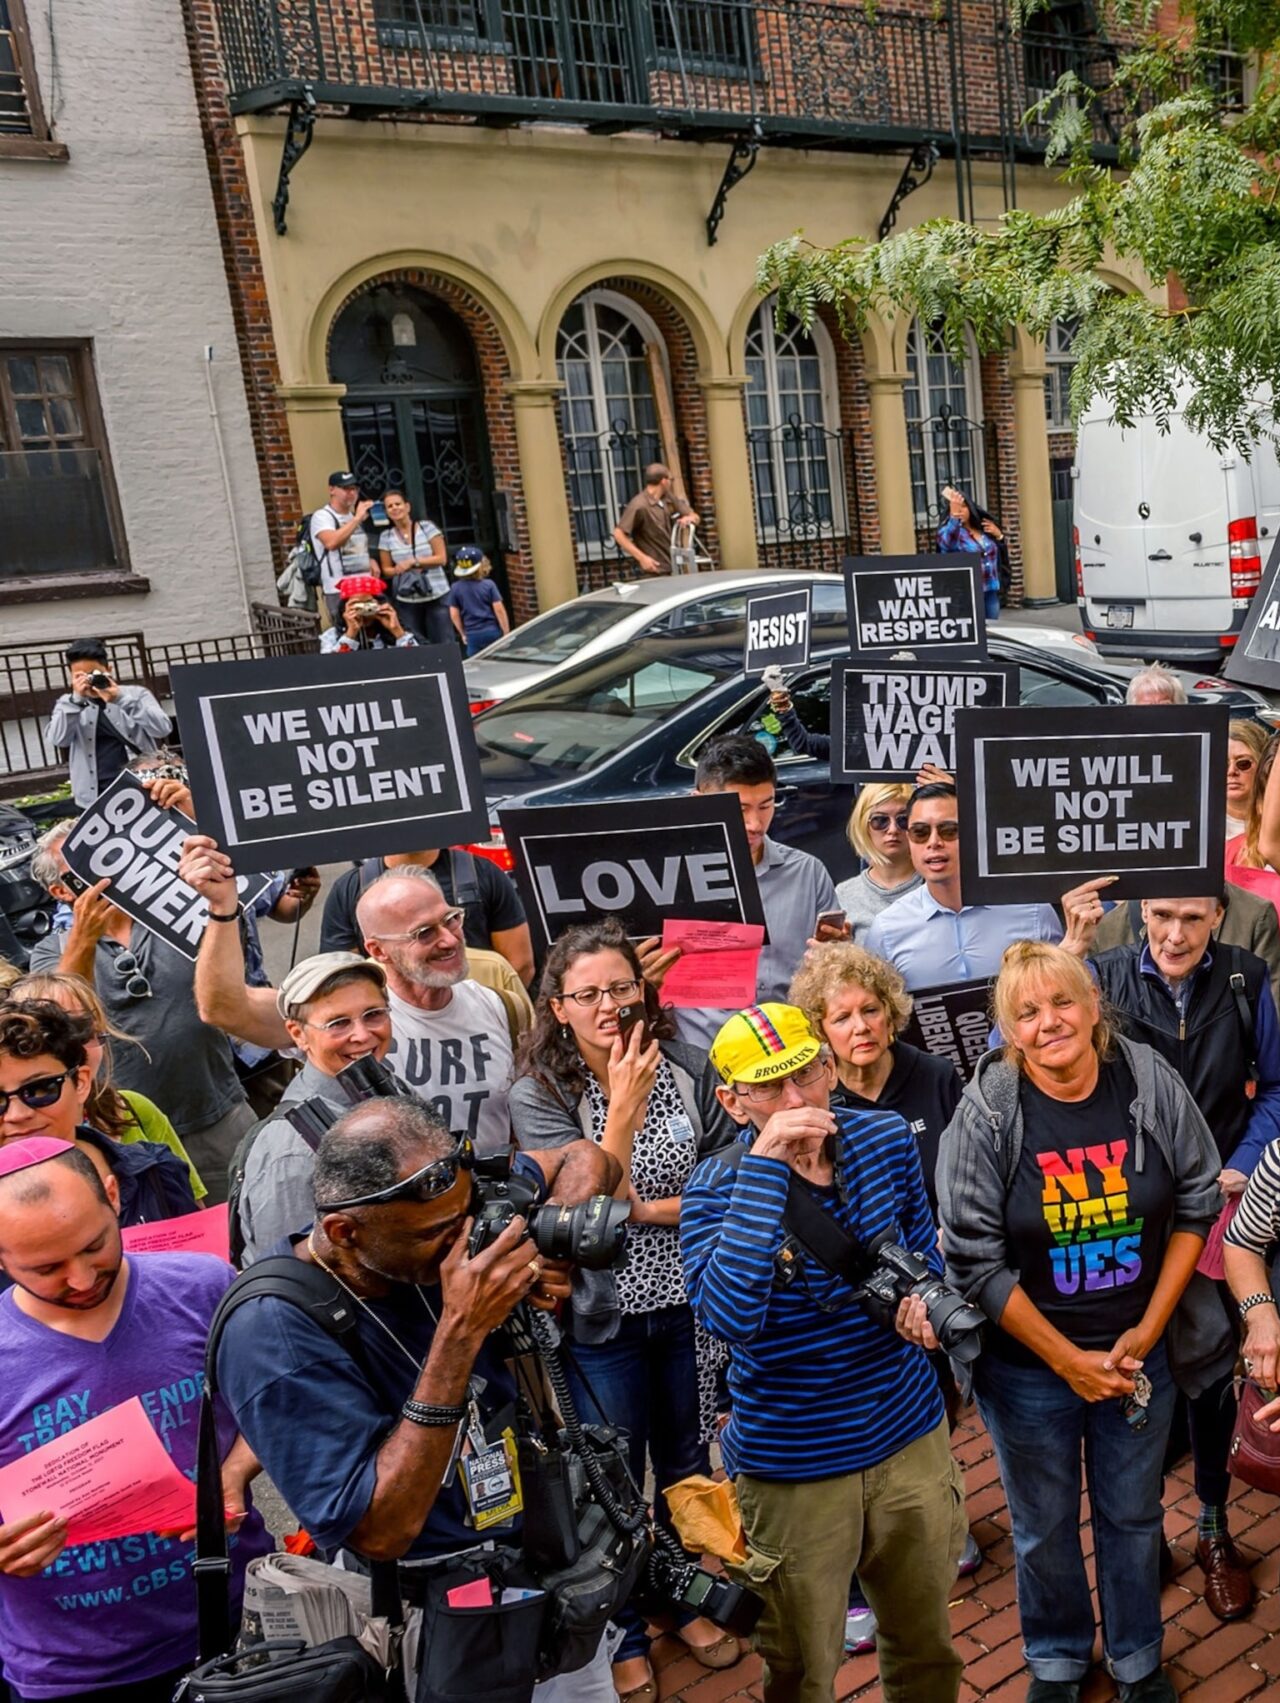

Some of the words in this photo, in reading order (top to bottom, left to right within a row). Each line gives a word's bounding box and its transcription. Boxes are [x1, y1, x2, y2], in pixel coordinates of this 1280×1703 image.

[894, 576, 934, 598] WE
[878, 597, 951, 620] WANT
[748, 612, 808, 651] RESIST
[860, 618, 972, 643] RESPECT
[862, 674, 987, 706] TRUMP
[243, 709, 311, 745] WE
[317, 698, 418, 736] WILL
[862, 703, 957, 735] WAG
[296, 736, 380, 776] NOT
[863, 733, 956, 770] WA
[1010, 757, 1070, 788] WE
[1081, 754, 1173, 786] WILL
[239, 783, 297, 820] BE
[306, 763, 446, 811] SILENT
[1055, 789, 1133, 821] NOT
[996, 826, 1046, 856] BE
[1057, 820, 1191, 854] SILENT
[69, 813, 211, 946] POWER
[534, 852, 736, 913] LOVE
[754, 1046, 816, 1080] BROOKLYN
[1036, 1139, 1129, 1204] NY
[1042, 1193, 1145, 1247] VAL
[1049, 1234, 1143, 1295] UES
[32, 1389, 91, 1429] GAY
[468, 1449, 503, 1466] NATIONAL
[470, 1455, 506, 1476] PRESS
